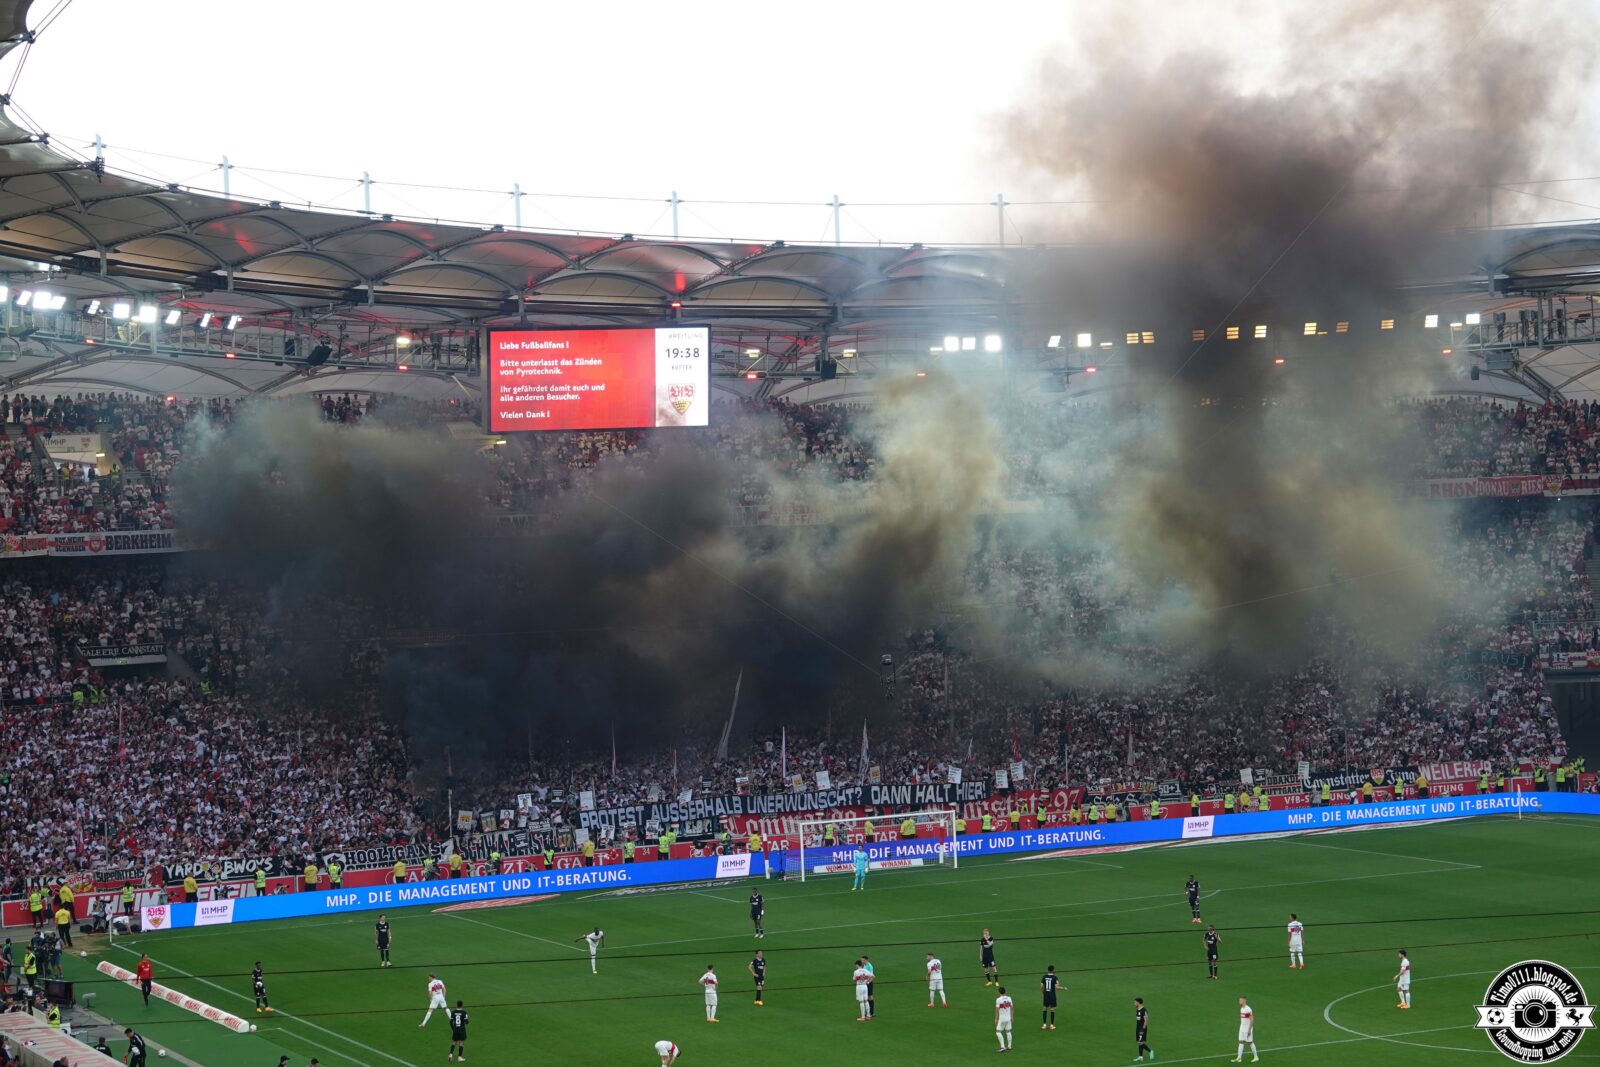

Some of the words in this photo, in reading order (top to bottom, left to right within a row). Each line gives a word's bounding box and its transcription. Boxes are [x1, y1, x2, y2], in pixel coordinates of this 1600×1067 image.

[499, 342, 519, 350] Liebe
[521, 341, 565, 350] Fußballfans
[665, 347, 700, 359] 19:38
[500, 359, 519, 367] Bitte
[521, 359, 558, 367] unterlasst
[560, 358, 573, 366] das
[574, 358, 602, 366] Zünden
[516, 367, 563, 377] Pyrotechnik.
[500, 385, 511, 393] Ihr
[513, 384, 548, 395] gefährdet
[549, 384, 571, 392] damit
[572, 384, 589, 392] euch
[591, 383, 605, 391] und
[500, 394, 513, 402] alle
[515, 394, 544, 402] anderen
[546, 393, 581, 401] Besucher.
[500, 410, 523, 419] Vielen
[525, 410, 545, 418] Dank
[1479, 480, 1509, 496] DONAU
[1521, 478, 1542, 495] RIES
[105, 533, 173, 550] BERKHEIM
[121, 645, 164, 655] CANNSTATT
[1158, 783, 1181, 794] 50+1
[579, 805, 645, 829] PROTEST
[650, 794, 743, 823] AUSSERHALB
[870, 785, 912, 805] DANN
[915, 783, 952, 804] HALT
[955, 780, 987, 801] HIER!
[1288, 813, 1316, 825] MHP.
[1322, 810, 1341, 822] DIE
[1346, 804, 1427, 820] MANAGEMENT
[1431, 801, 1455, 813] UND
[925, 824, 934, 832] 35
[1194, 821, 1209, 830] MHP
[896, 839, 984, 857] MANAGEMENT
[988, 837, 1015, 849] UND
[1021, 829, 1106, 847] IT-BERATUNG.
[343, 841, 442, 865] HOOLIGANS
[642, 847, 650, 855] 34
[730, 859, 746, 868] MHP
[880, 859, 913, 868] WINAMAX
[165, 862, 203, 879] YARD
[326, 893, 361, 908] MHP.
[368, 890, 392, 904] DIE
[398, 880, 496, 901] MANAGEMENT
[502, 878, 531, 892] UND
[537, 869, 632, 888] IT-BERATUNG.
[20, 902, 29, 911] 32
[210, 905, 228, 914] MHP
[1045, 979, 1051, 990] 11
[455, 1015, 461, 1025] 8
